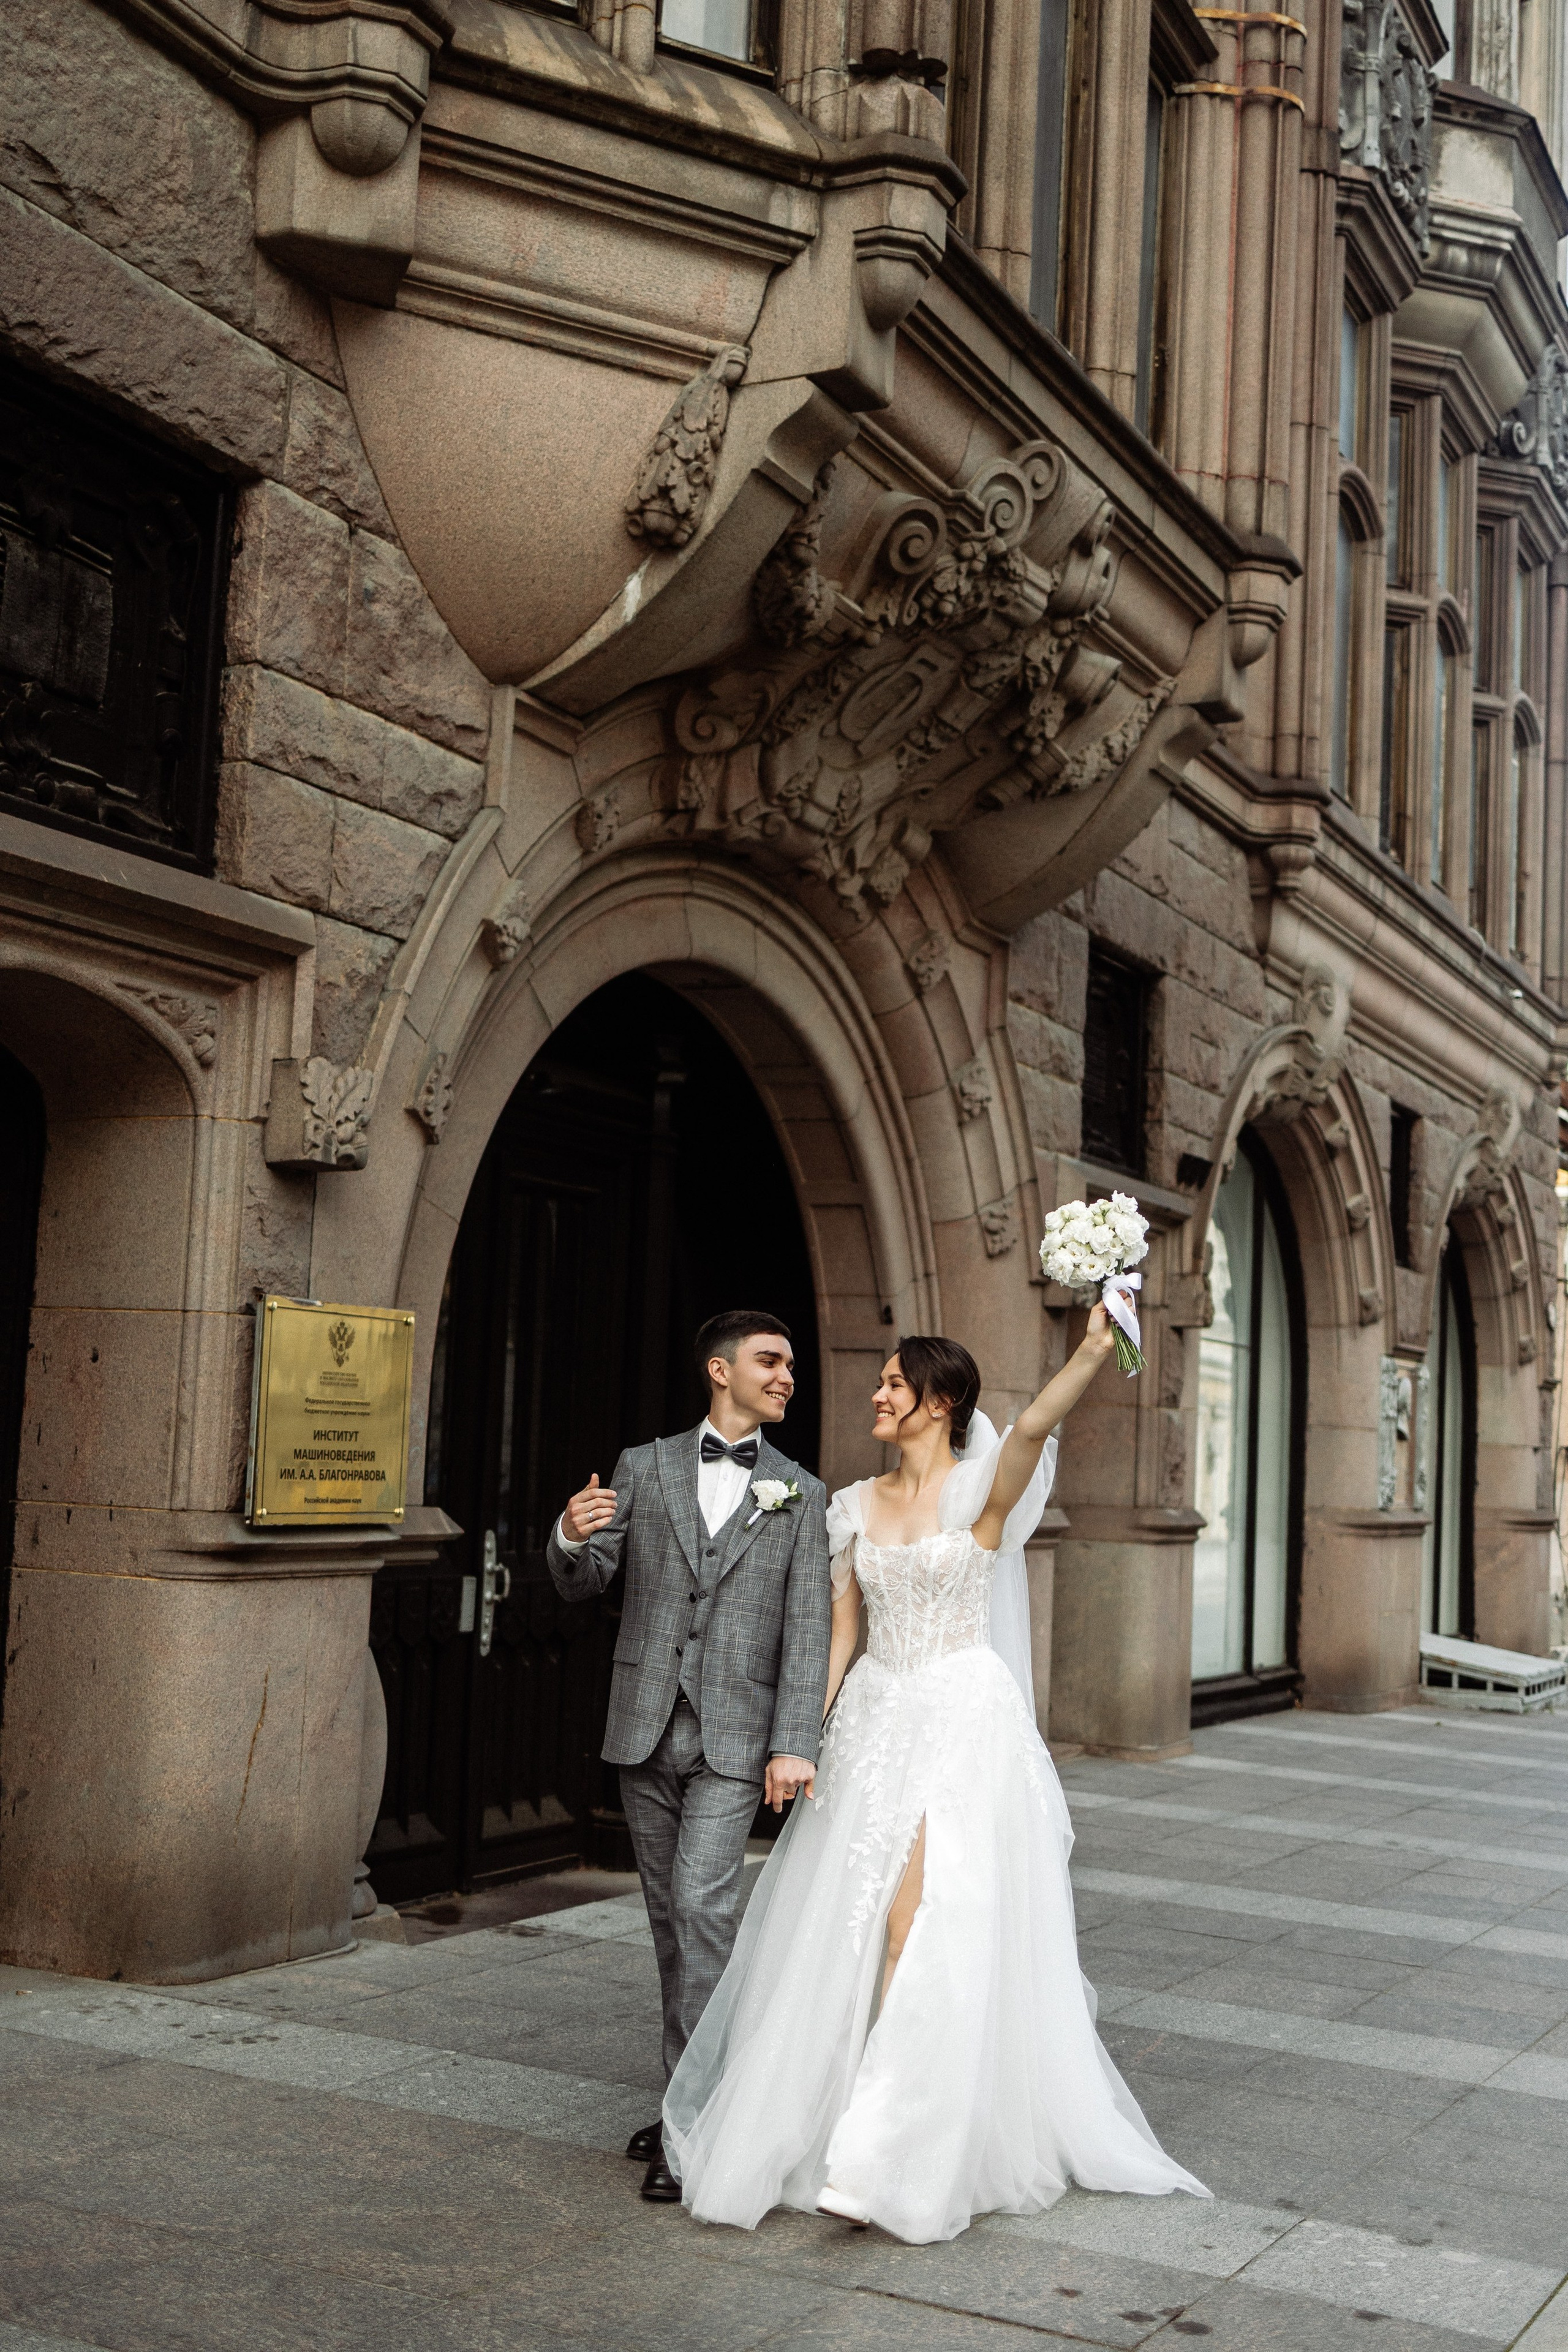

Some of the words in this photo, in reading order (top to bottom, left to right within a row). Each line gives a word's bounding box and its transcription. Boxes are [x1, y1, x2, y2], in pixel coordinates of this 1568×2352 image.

[313, 1430, 360, 1442] ИНСТИТУТ
[293, 1449, 376, 1464] МАШИНОВЕДЕНИЯ
[280, 1468, 298, 1480] ИМ.
[300, 1469, 317, 1480] А.А.
[319, 1469, 386, 1481] БЛАГОНРАВОВА
